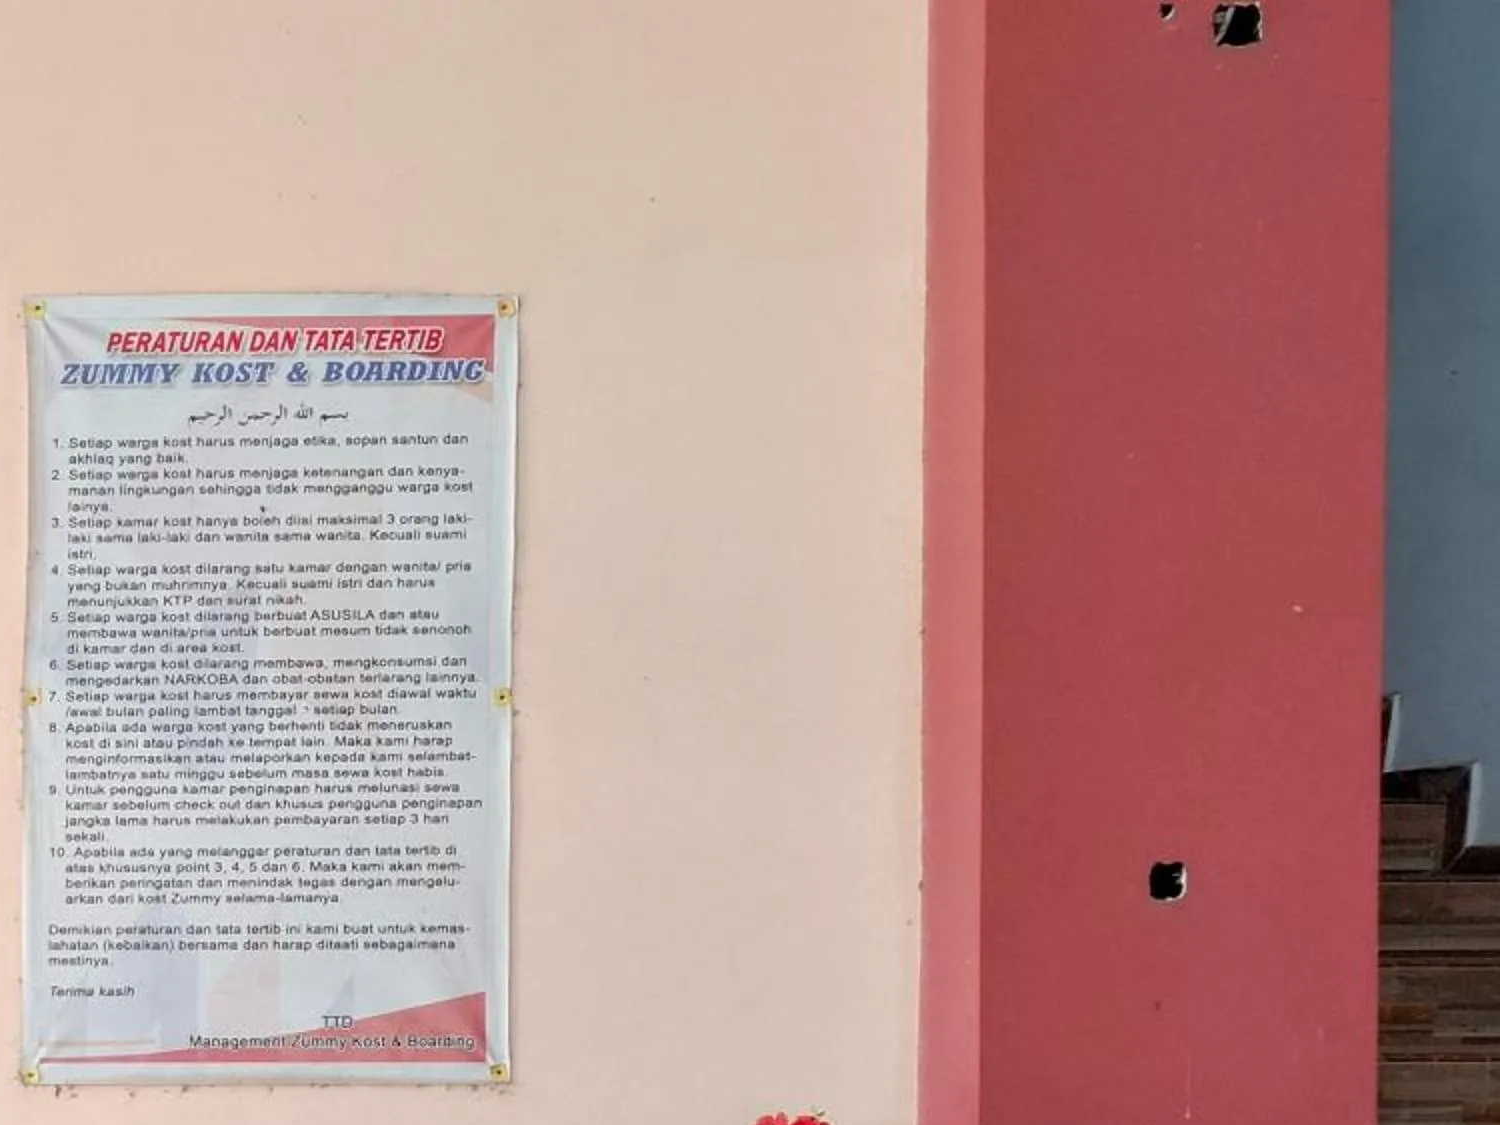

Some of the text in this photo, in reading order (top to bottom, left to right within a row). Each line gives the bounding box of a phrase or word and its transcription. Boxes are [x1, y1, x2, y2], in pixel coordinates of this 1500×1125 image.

[107, 328, 443, 354] PERATURAN DAN TATA TERTIB
[61, 359, 485, 385] ZUMMY KOST & BOARDING
[69, 434, 468, 451] Setiap warga kost harus menjaga sopan santun dan
[68, 452, 153, 467] akhlaq yang
[69, 465, 414, 482] Setiap warga kost harus menjaga ketenangan dan
[199, 481, 473, 497] sehingga tidak mengganggu warga kost
[68, 513, 439, 530] Setiap kamar kost hanya 3 orang
[96, 529, 466, 543] sama dan wanita sama Kecuali suami
[68, 561, 471, 578] Setiap warga kost dengan pria
[68, 576, 435, 593] yang Kecuali suami istri dan harus
[160, 594, 223, 607] KTP dan
[67, 608, 439, 625] Setiap warga kost berbuat ASUSILA dan atau
[68, 624, 408, 638] membawa untuk berbuat tidak
[129, 642, 155, 654] dan
[67, 656, 466, 673] Setiap warga kost mengkonsumsi dan
[66, 671, 421, 688] mengedarkan NARKOBA dan terlarang
[66, 687, 476, 704] Setiap warga kost harus kost diawal waktu
[148, 704, 355, 720] paling lambat tanggal setiap
[66, 719, 452, 736] Apabila ada warga kost yang berhenti tidak meneruskan
[66, 734, 452, 750] kost atau pindah tempat Maka kami harap
[196, 750, 403, 766] atau kepada kami
[174, 766, 403, 782] minggu sebelum masa kost
[66, 782, 353, 795] Untuk kamar harus
[112, 798, 323, 811] sebelum check dan khusus
[152, 812, 419, 828] harus pembayaran setiap 3
[73, 844, 370, 861] Apabila ada yang peraturan dan
[175, 859, 423, 875] point dan Maka kami akan
[197, 875, 392, 890] dan dengan
[65, 891, 222, 906] arkan kost Zummy
[116, 922, 415, 939] peraturan dan kami buat untuk
[178, 938, 312, 953] bersama dan harap
[190, 1034, 350, 1049] Management Zummy
